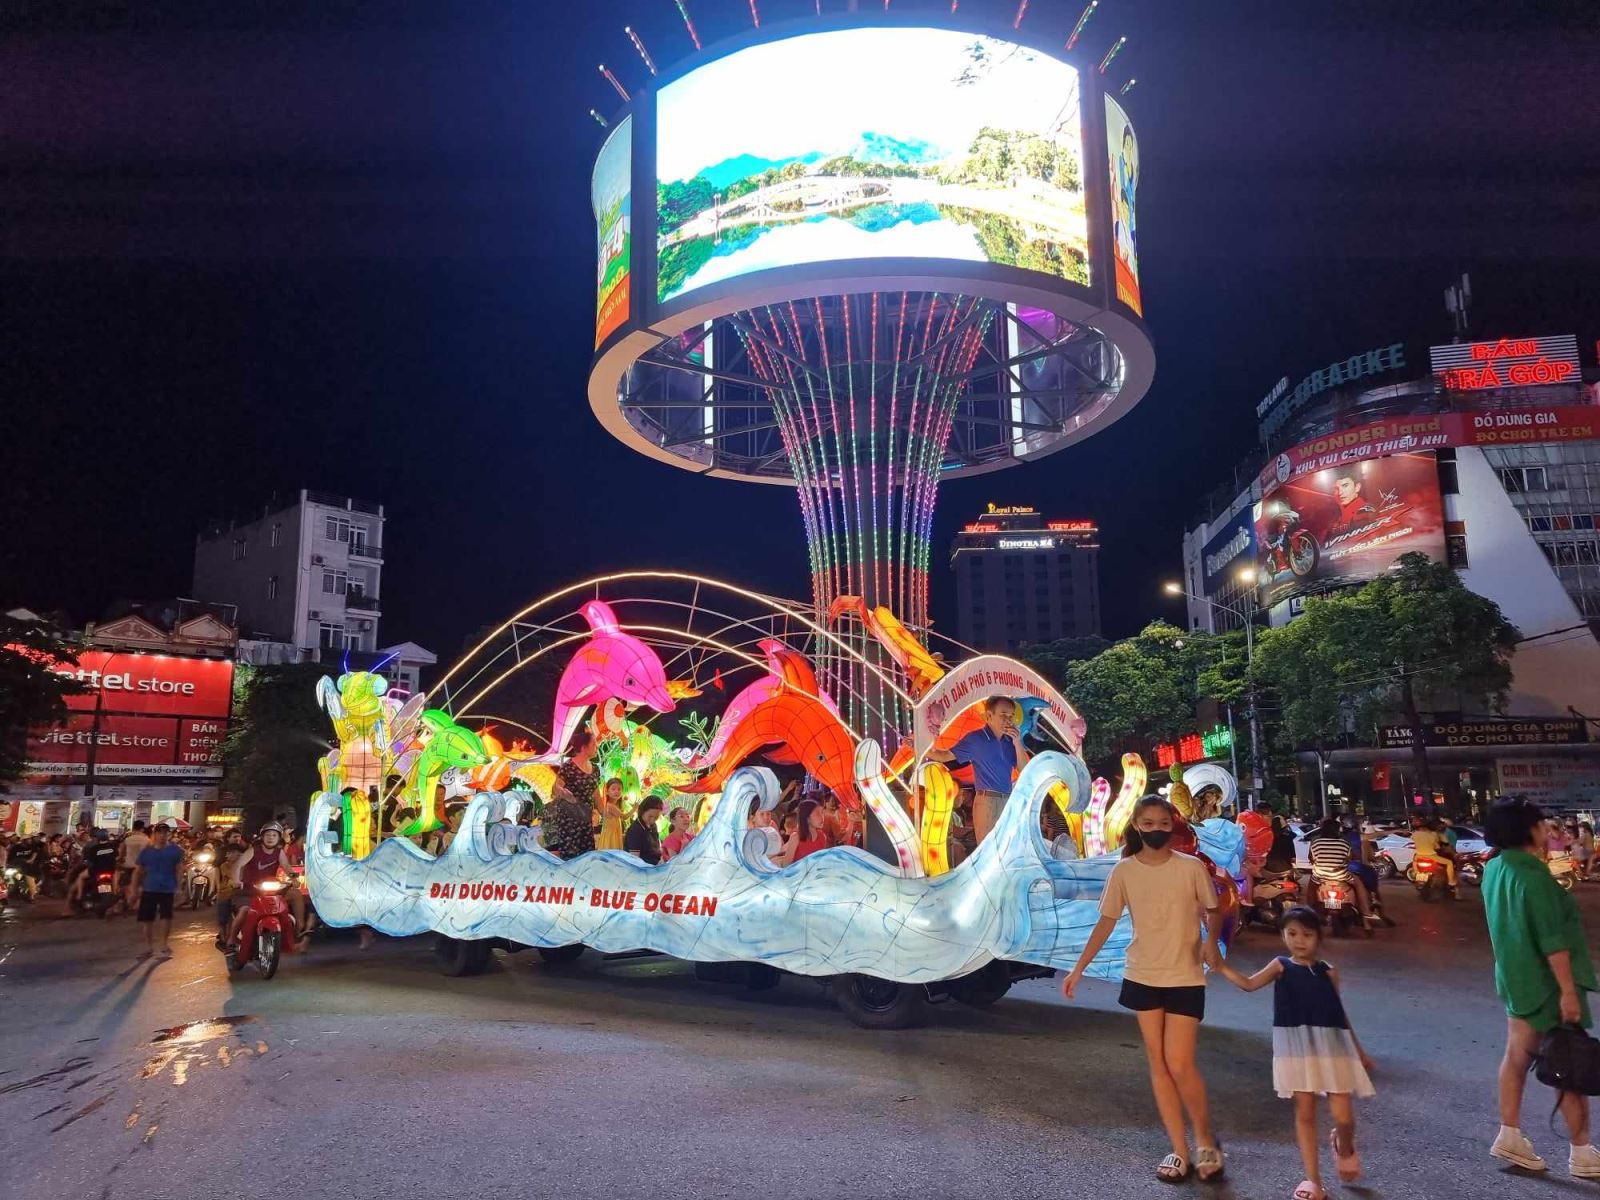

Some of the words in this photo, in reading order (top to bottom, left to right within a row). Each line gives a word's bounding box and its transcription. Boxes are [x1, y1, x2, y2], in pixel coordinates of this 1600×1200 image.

[1470, 337, 1537, 361] BÁN
[1439, 359, 1502, 390] TRẢ
[1508, 356, 1573, 385] GÓP
[1255, 375, 1289, 418] TOPLAND
[1496, 411, 1533, 427] DÙNG
[1534, 412, 1558, 425] GIA
[1299, 425, 1386, 459] WONDER
[1392, 416, 1440, 437] land
[1571, 425, 1593, 436] EM
[1295, 458, 1316, 475] KHU
[1319, 452, 1338, 466] VUI
[1341, 443, 1371, 460] CHƠI
[1421, 434, 1448, 446] NHI
[987, 503, 1011, 514] Royal
[138, 678, 195, 694] store
[951, 680, 968, 703] DÂN
[968, 669, 985, 690] PHỐ
[985, 671, 992, 685] 6
[993, 668, 1024, 689] PHƯỜNG
[192, 721, 217, 733] BÁN
[1511, 722, 1540, 732] GIA
[122, 735, 168, 747] store
[458, 880, 518, 902] DƯƠNG
[522, 885, 575, 905] XANH
[590, 888, 637, 911] BLUE
[643, 893, 718, 917] OCEAN
